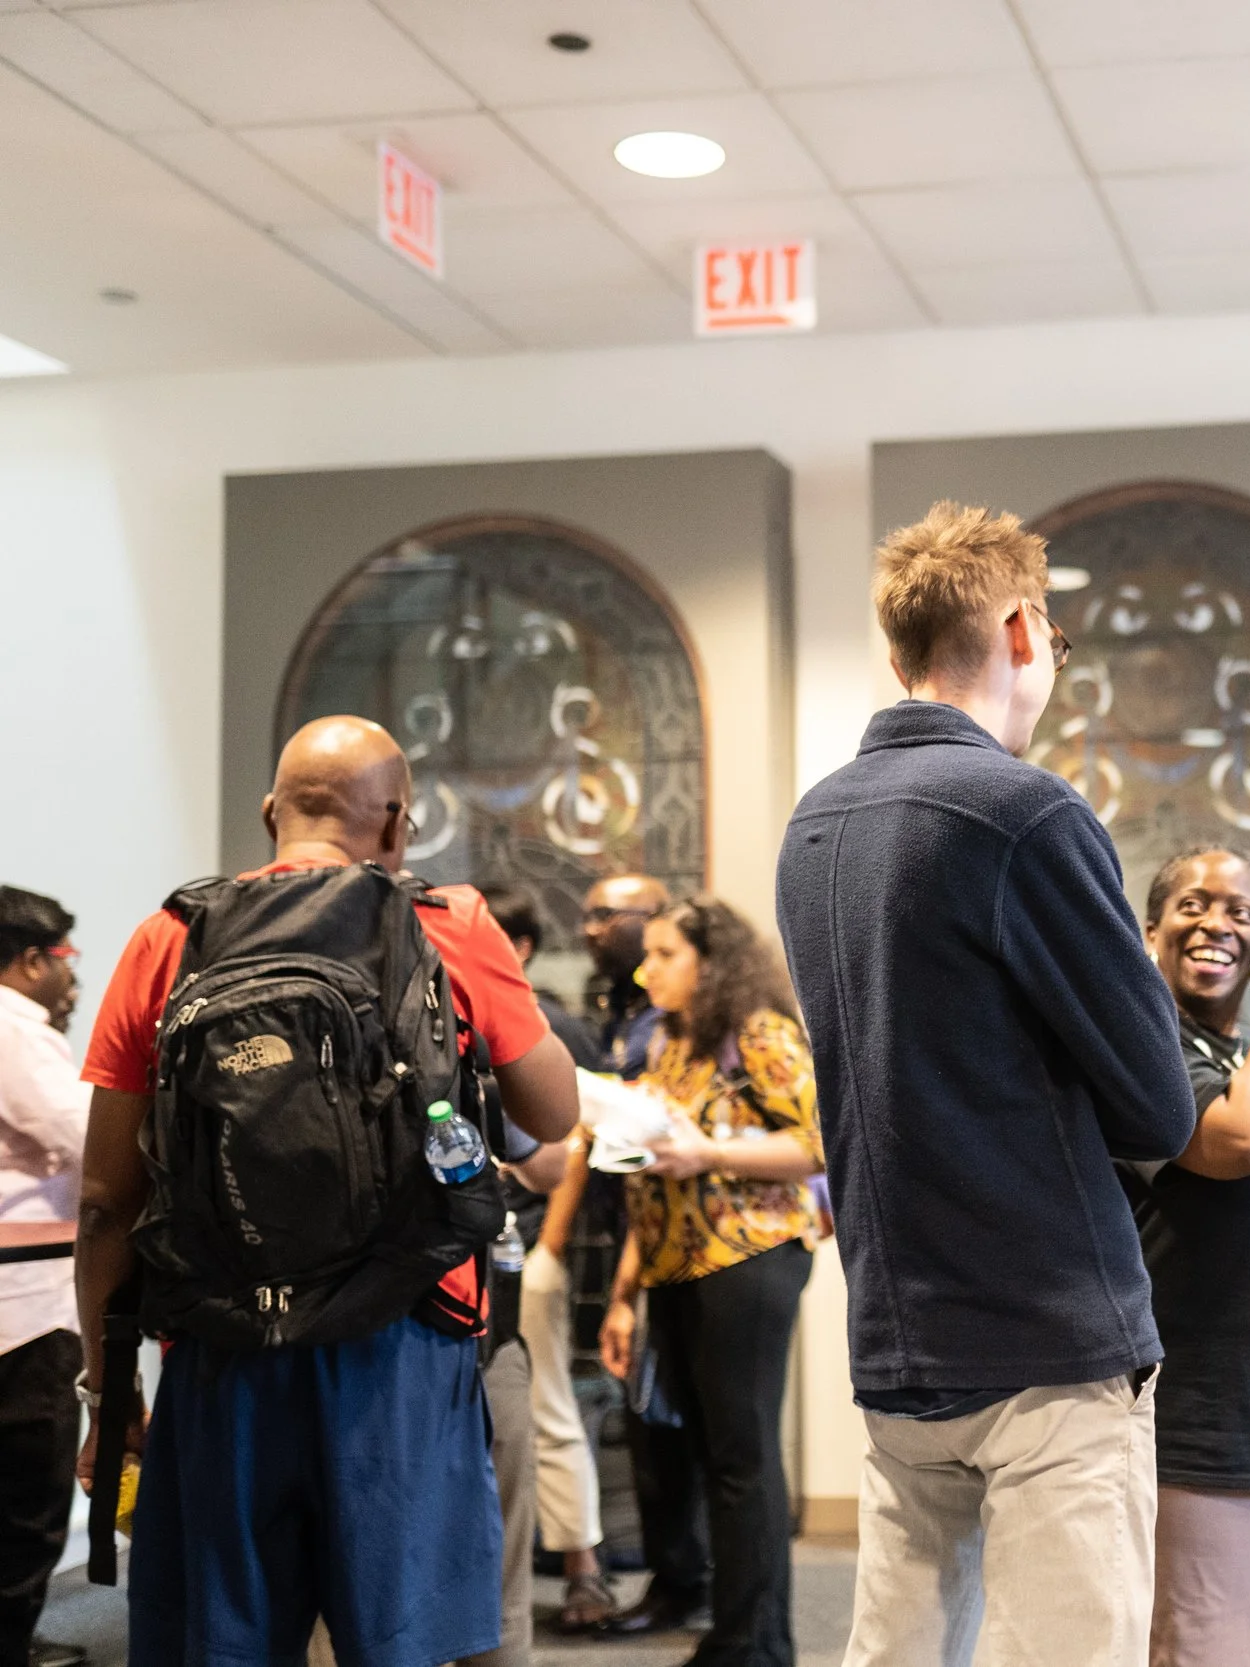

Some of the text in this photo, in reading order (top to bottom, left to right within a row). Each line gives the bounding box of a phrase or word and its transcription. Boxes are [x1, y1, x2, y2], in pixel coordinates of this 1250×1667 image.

[383, 151, 436, 251] EXIT
[704, 243, 803, 311] EXIT
[215, 1045, 266, 1072] NORTH
[233, 1038, 264, 1054] THE
[233, 1058, 269, 1077] FACE
[219, 1118, 247, 1212] OLARIS
